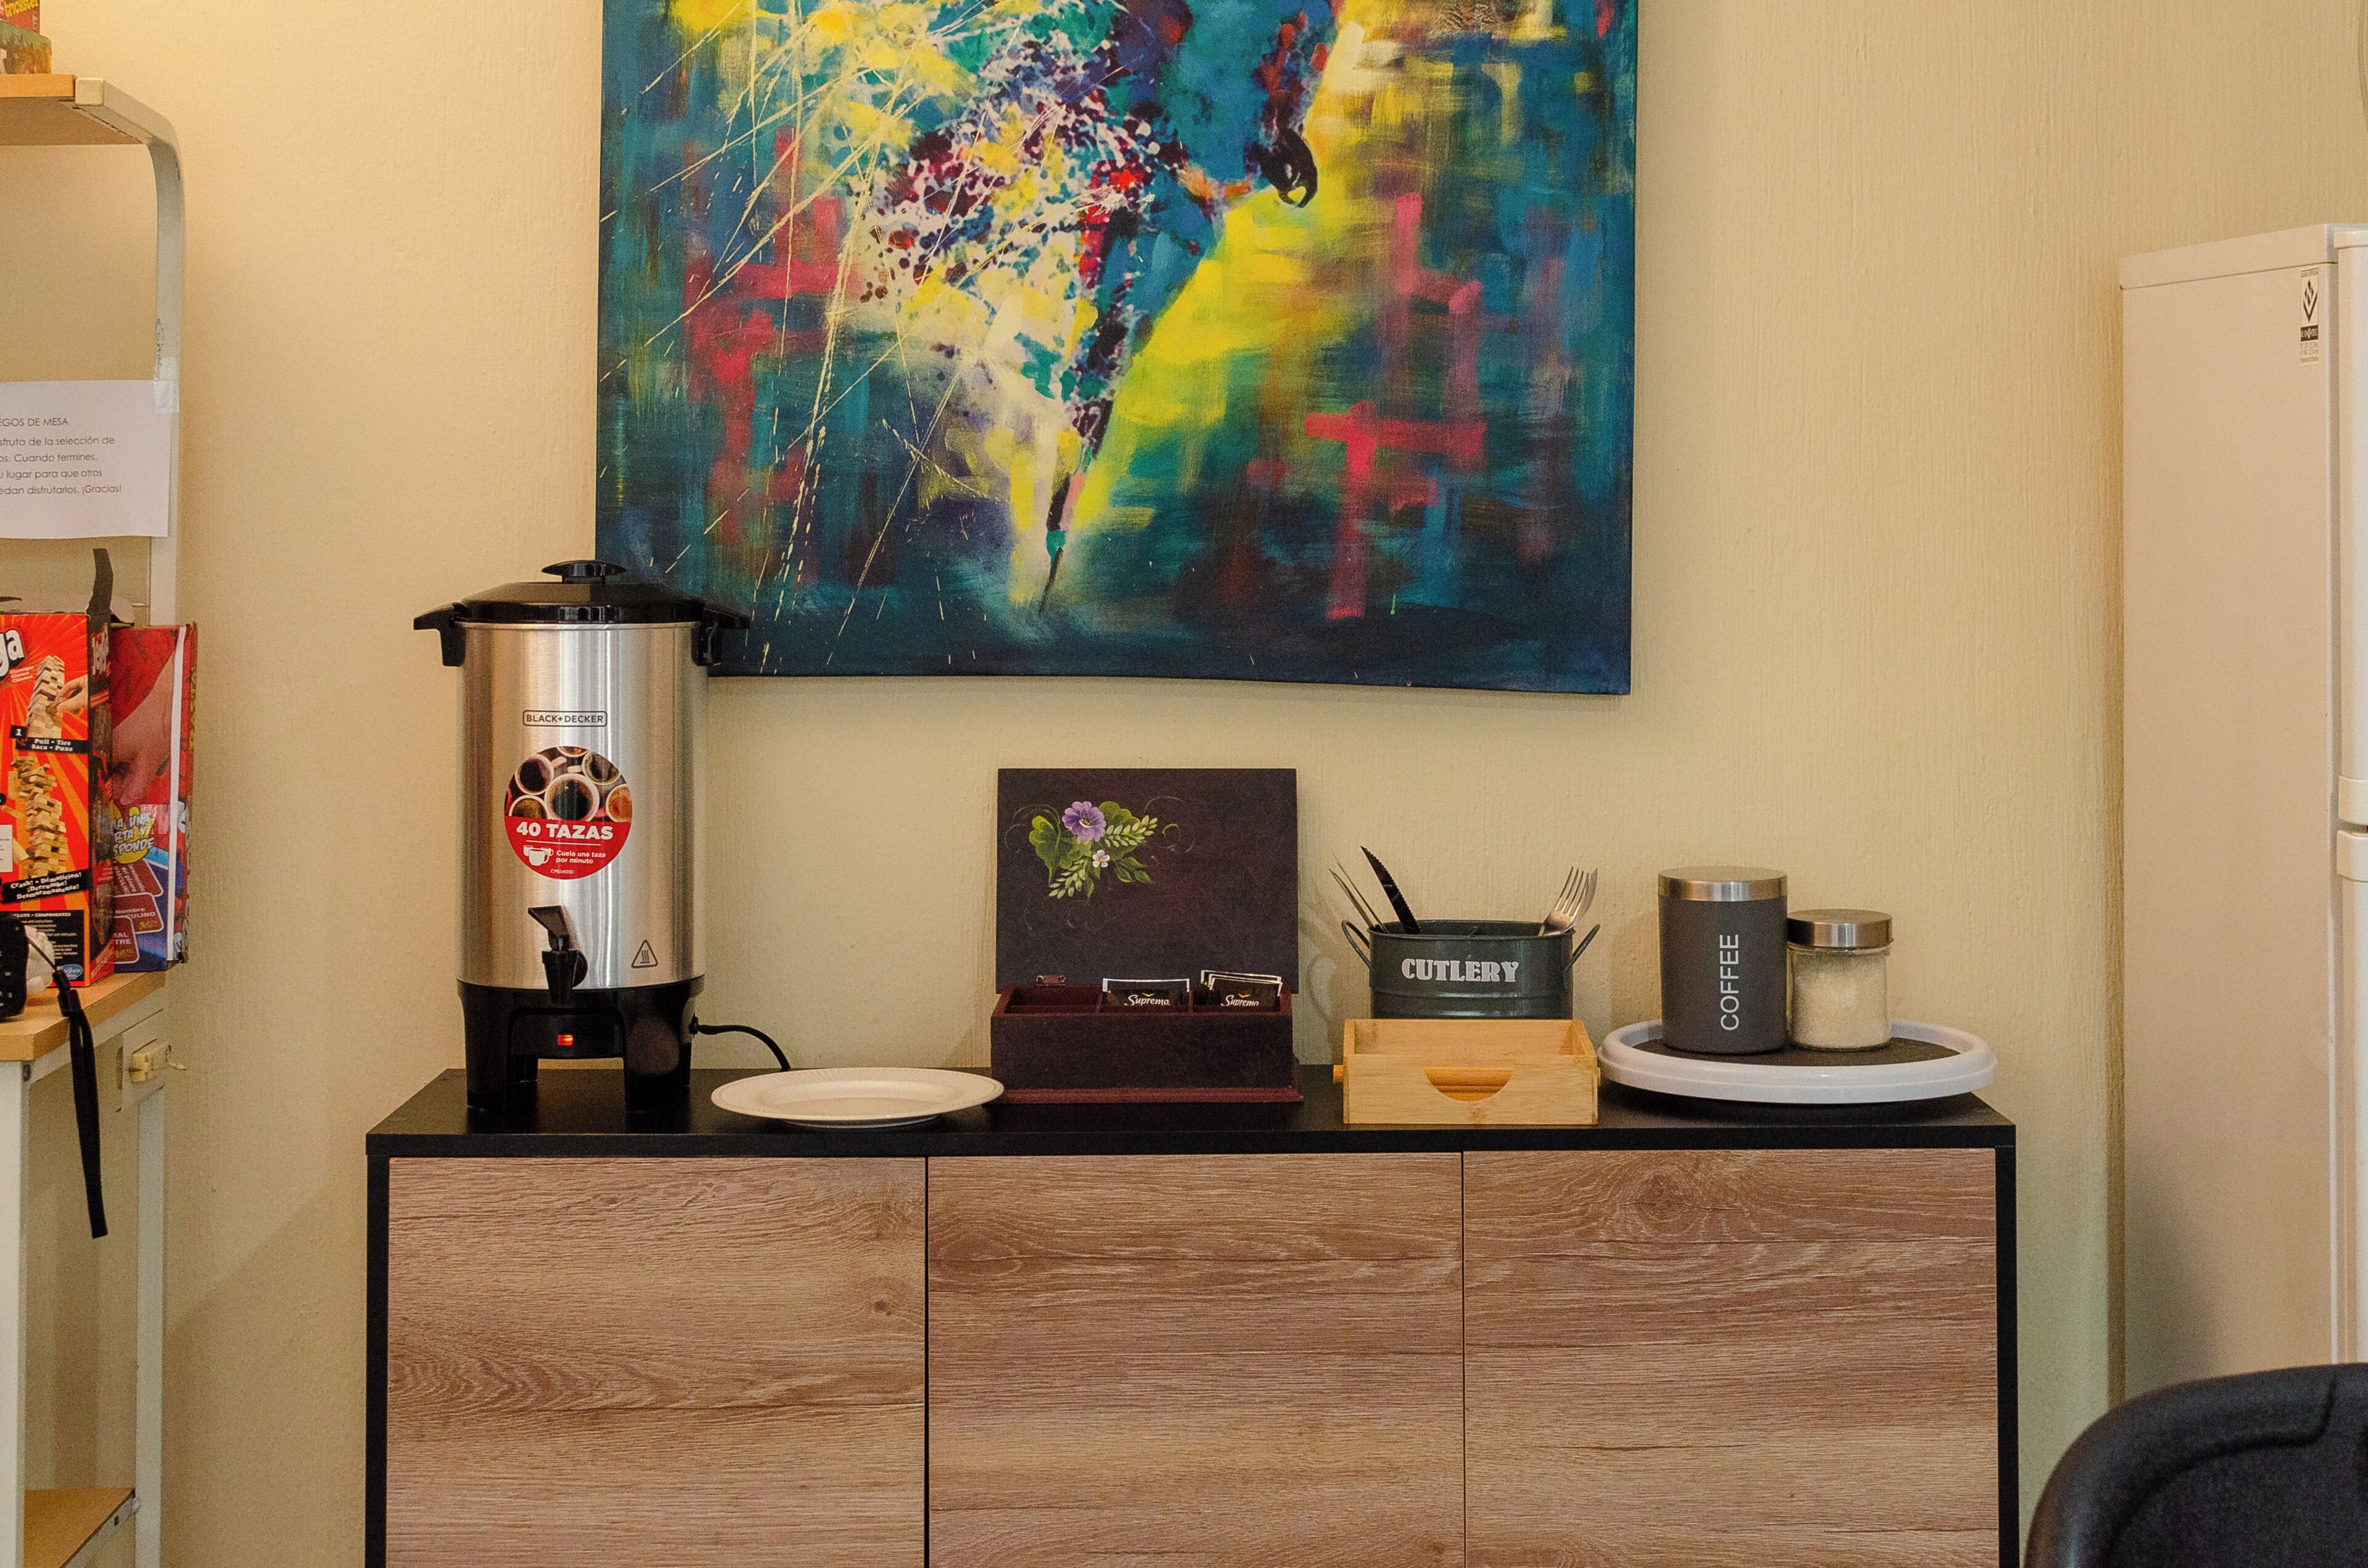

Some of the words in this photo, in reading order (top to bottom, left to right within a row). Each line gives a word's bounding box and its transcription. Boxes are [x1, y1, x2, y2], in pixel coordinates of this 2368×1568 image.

[28, 418, 41, 427] DE
[43, 417, 68, 426] MESA
[28, 437, 42, 446] de
[44, 437, 54, 446] la
[56, 436, 99, 445] selección
[102, 436, 115, 445] de
[14, 453, 55, 462] Cuando
[7, 470, 31, 480] lugar
[35, 471, 59, 480] para
[60, 470, 79, 479] que
[81, 469, 102, 477] otros
[27, 485, 80, 495] disfrutarlos.
[81, 484, 122, 495] ¡Gracias!
[526, 715, 604, 723] BLACK+DECKER
[15, 728, 22, 736] 1
[516, 821, 541, 837] 40
[546, 823, 614, 840] TAZAS
[10, 880, 33, 889] Crash!
[1402, 958, 1519, 983] CUTLERY
[1719, 934, 1740, 1031] COFFEE
[1124, 994, 1169, 1006] Supremo
